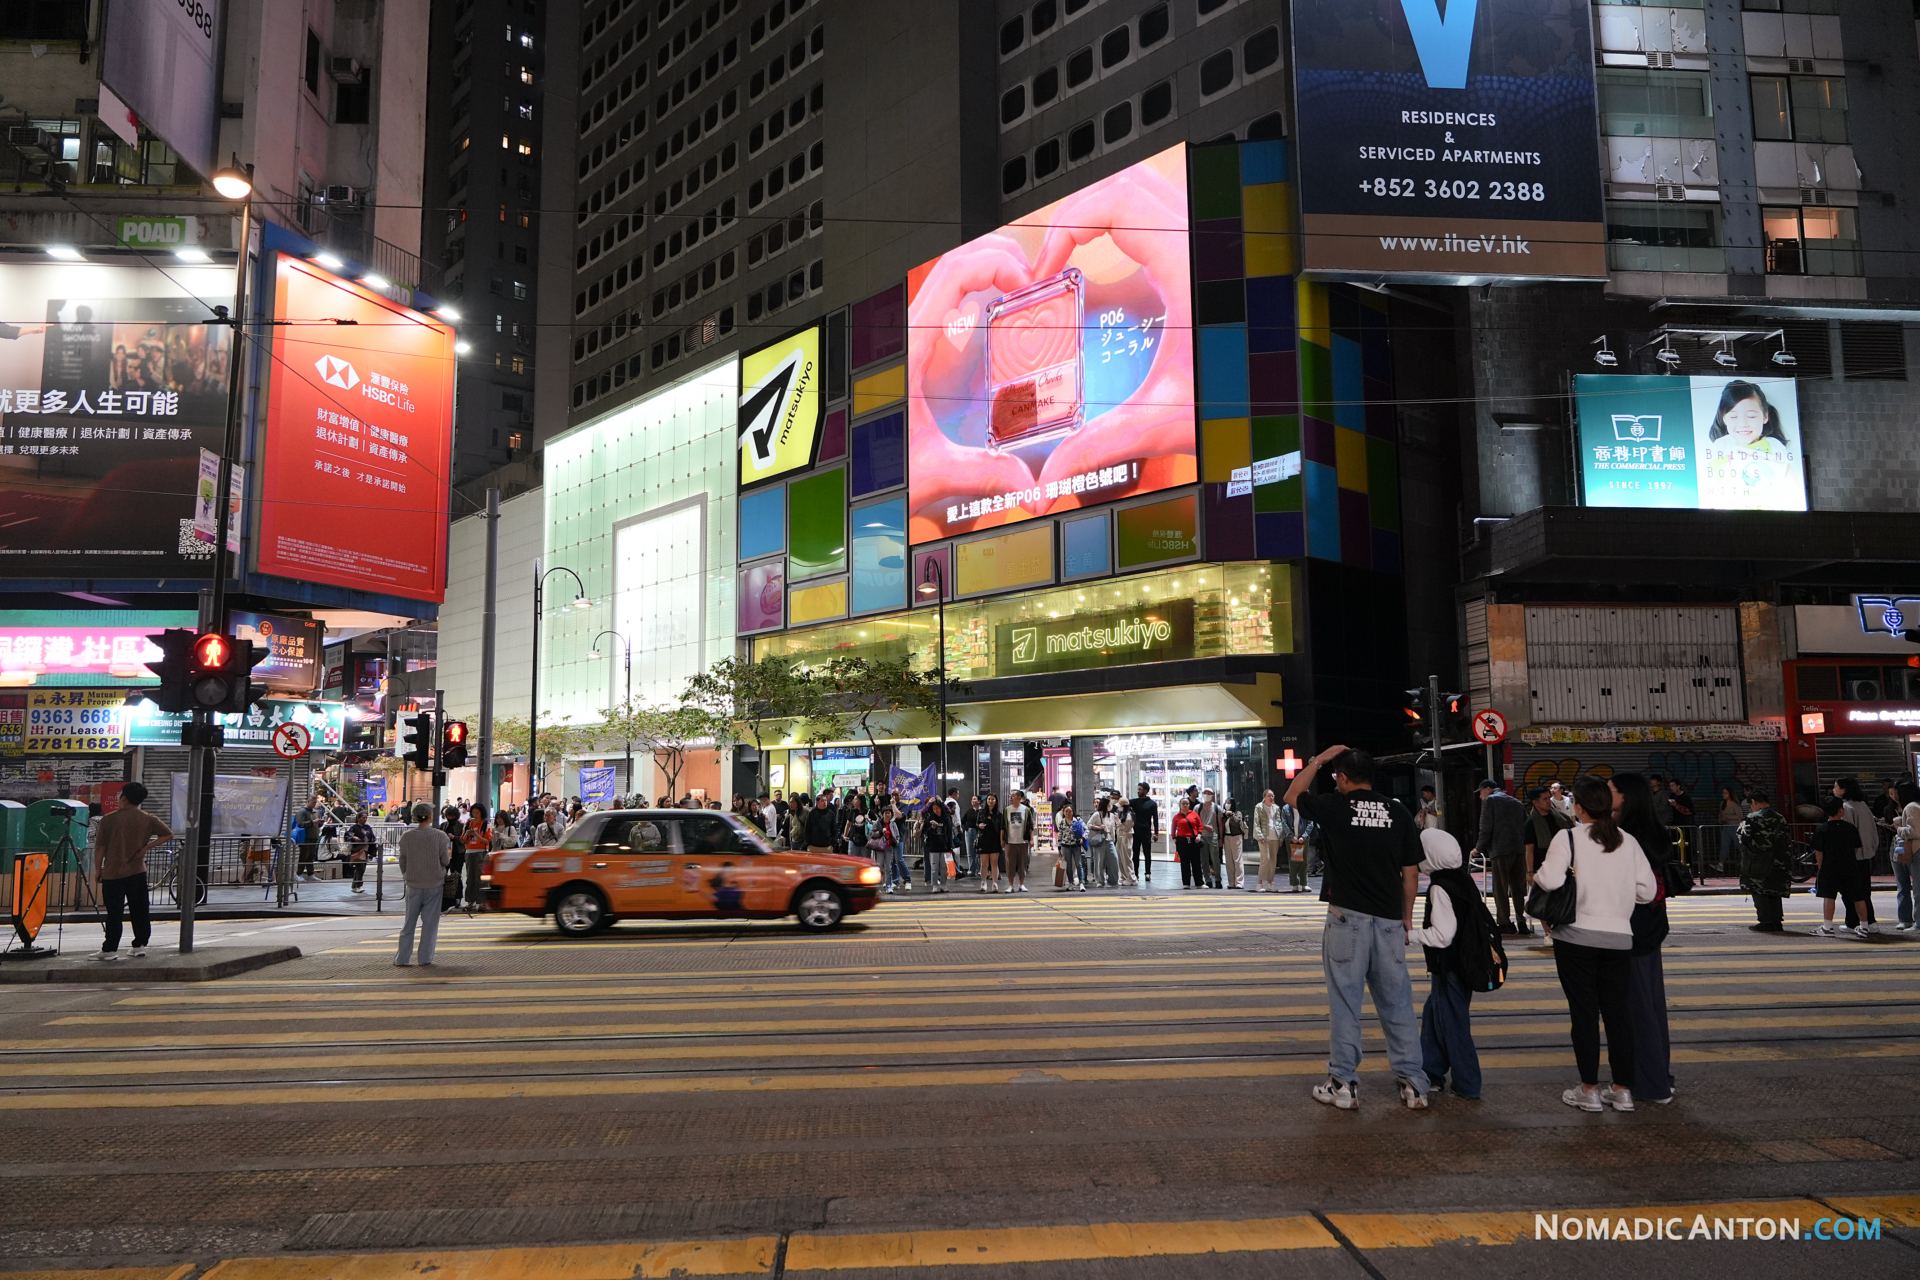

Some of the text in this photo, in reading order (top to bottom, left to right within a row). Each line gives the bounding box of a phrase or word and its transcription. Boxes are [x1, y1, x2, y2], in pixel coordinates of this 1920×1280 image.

[1401, 110, 1496, 126] RESIDENCES
[1445, 131, 1455, 144] &
[1359, 146, 1541, 165] SERVICED APARTMENTS
[1358, 178, 1545, 201] +852 3602 2388
[122, 222, 180, 244] POAD
[948, 314, 976, 338] NEW
[1100, 308, 1124, 329] P06
[1101, 315, 1168, 347] ジューシー
[1102, 337, 1154, 364] コーラル
[362, 383, 416, 413] HSBC Life
[780, 361, 812, 446] matsukiyo
[1012, 396, 1054, 416] CANMAKE
[80, 428, 130, 440] 退休計劃
[1593, 445, 1686, 462] 商務印書館
[1706, 448, 1794, 460] BRIDGING
[1609, 481, 1672, 490] SINCE 1897
[1046, 618, 1171, 654] matsukiyo
[50, 692, 84, 706] 永昇
[31, 710, 120, 724] 9363 6681
[30, 725, 120, 736] 出 For Lease 租
[28, 738, 120, 750] 27811682
[1356, 800, 1386, 810] BACK
[1351, 817, 1393, 828] STREET
[1369, 810, 1390, 819] THE
